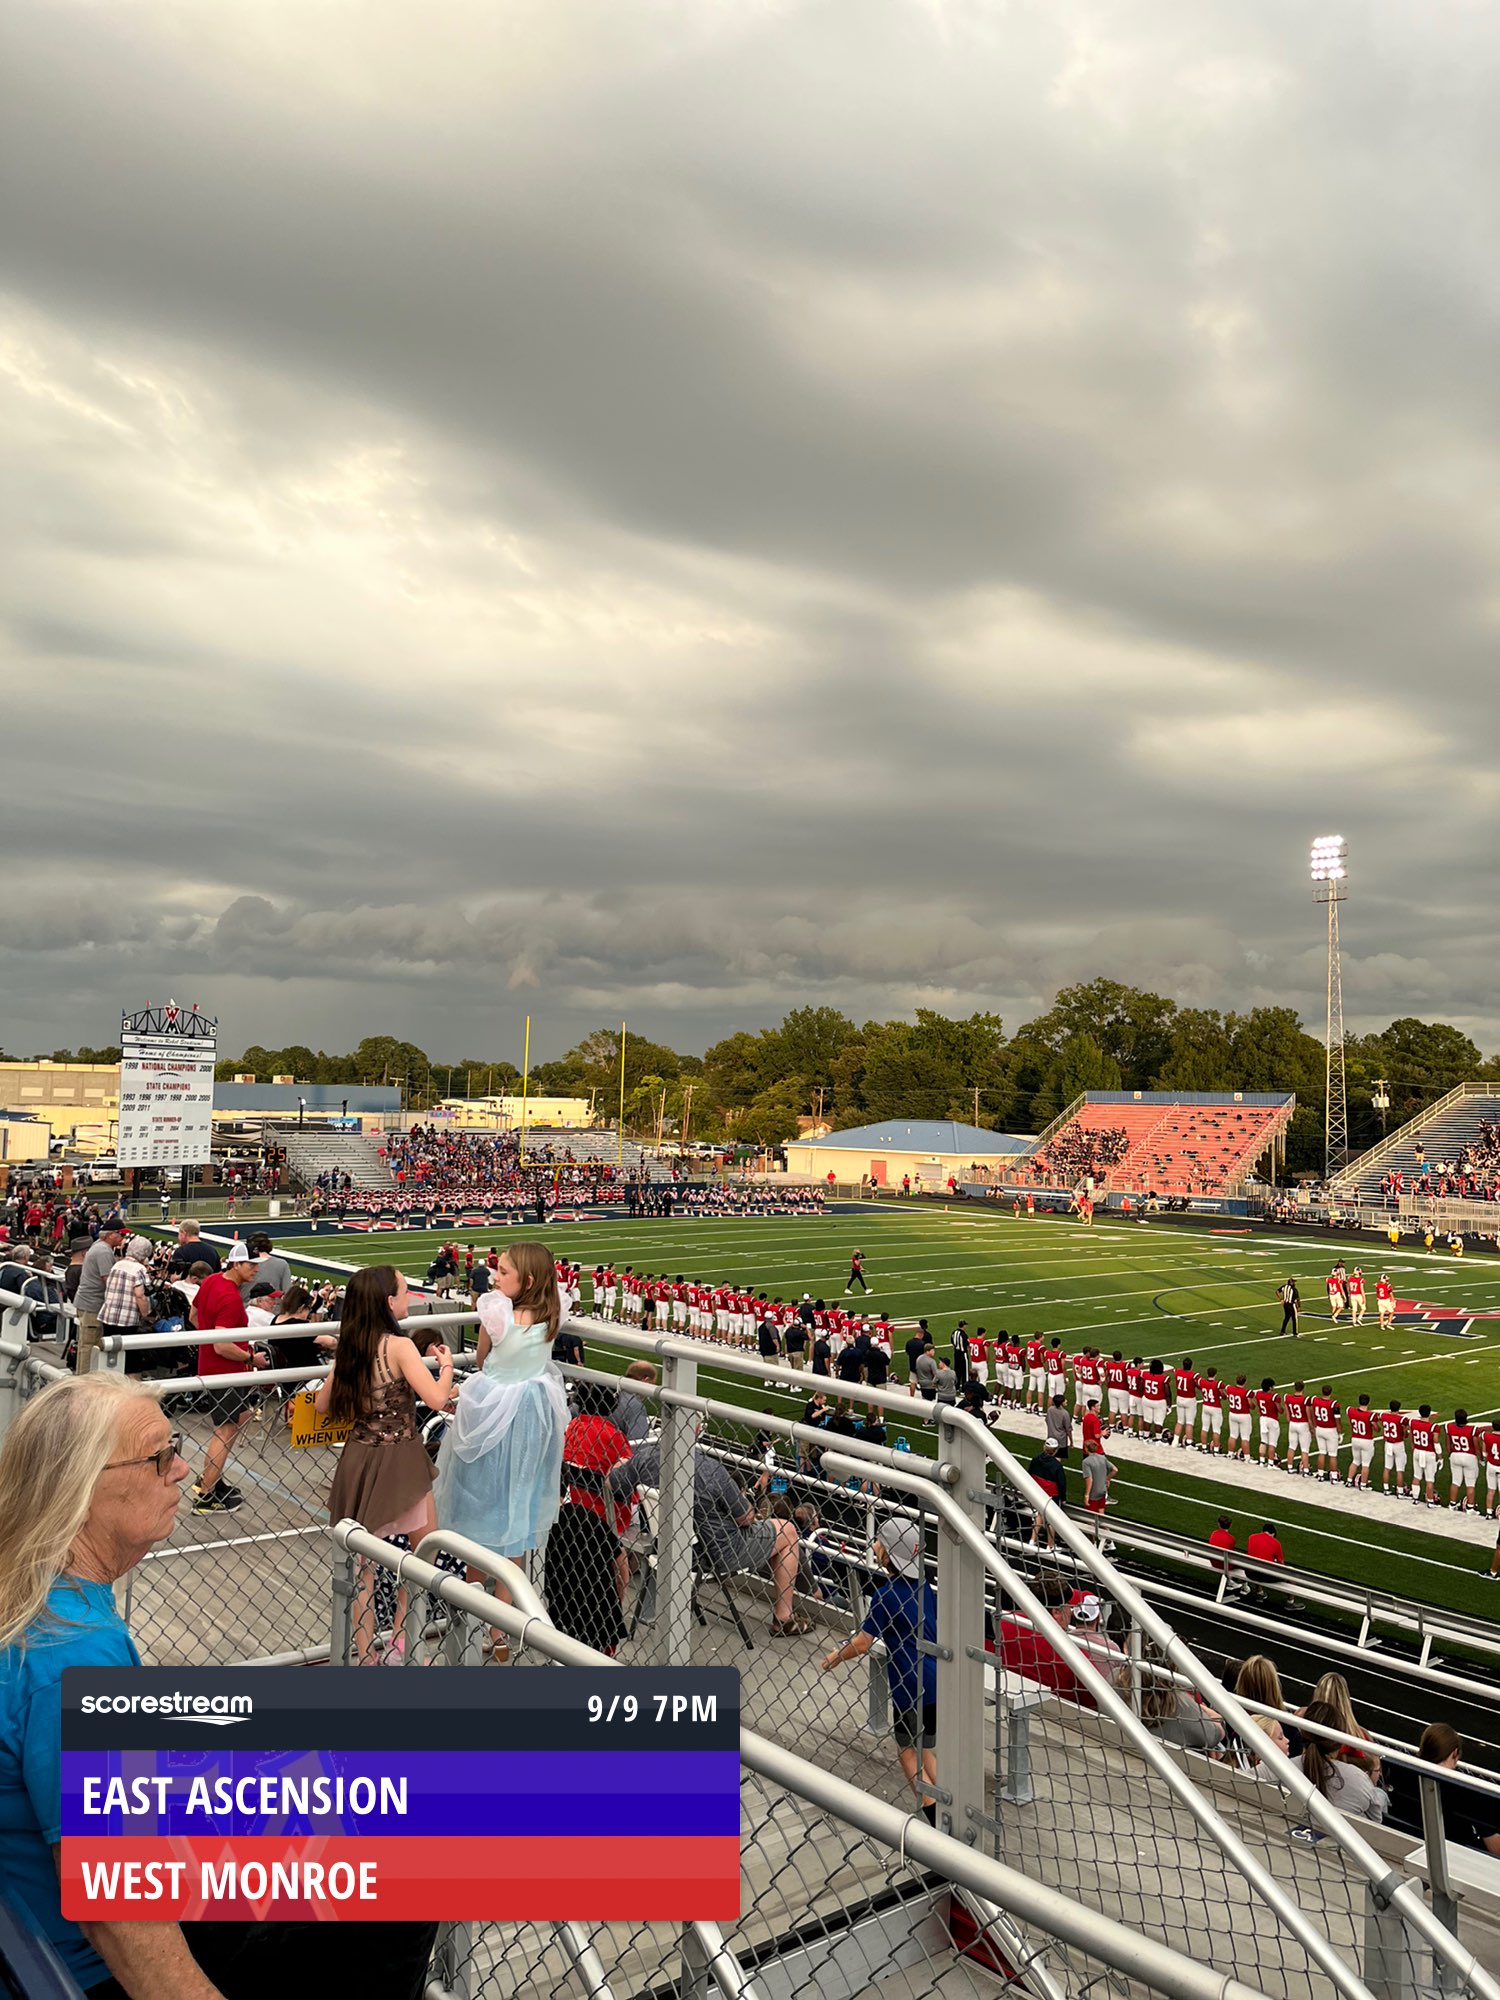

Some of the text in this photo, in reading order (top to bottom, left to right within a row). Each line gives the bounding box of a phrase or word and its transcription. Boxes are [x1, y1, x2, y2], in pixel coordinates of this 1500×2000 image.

[138, 1048, 157, 1056] Home
[166, 1049, 203, 1059] Champions!
[141, 1062, 166, 1071] NATIONAL
[167, 1063, 197, 1072] CHAMPIONS
[146, 1082, 191, 1091] STATE CHAMPIONS
[267, 1147, 286, 1163] 25
[969, 1343, 979, 1357] 78
[1047, 1358, 1058, 1371] 10
[1081, 1365, 1094, 1380] 92
[1109, 1369, 1123, 1383] 70
[1144, 1379, 1159, 1395] 55
[1176, 1376, 1188, 1392] 71
[1202, 1388, 1215, 1403] 34
[1228, 1394, 1242, 1410] 93
[1259, 1400, 1267, 1415] 5
[1288, 1403, 1303, 1419] 13
[1315, 1406, 1329, 1422] 48
[1351, 1418, 1366, 1436] 30
[1383, 1421, 1398, 1439] 23
[296, 1431, 333, 1445] WHEN
[1413, 1429, 1429, 1447] 28
[1451, 1435, 1470, 1452] 59
